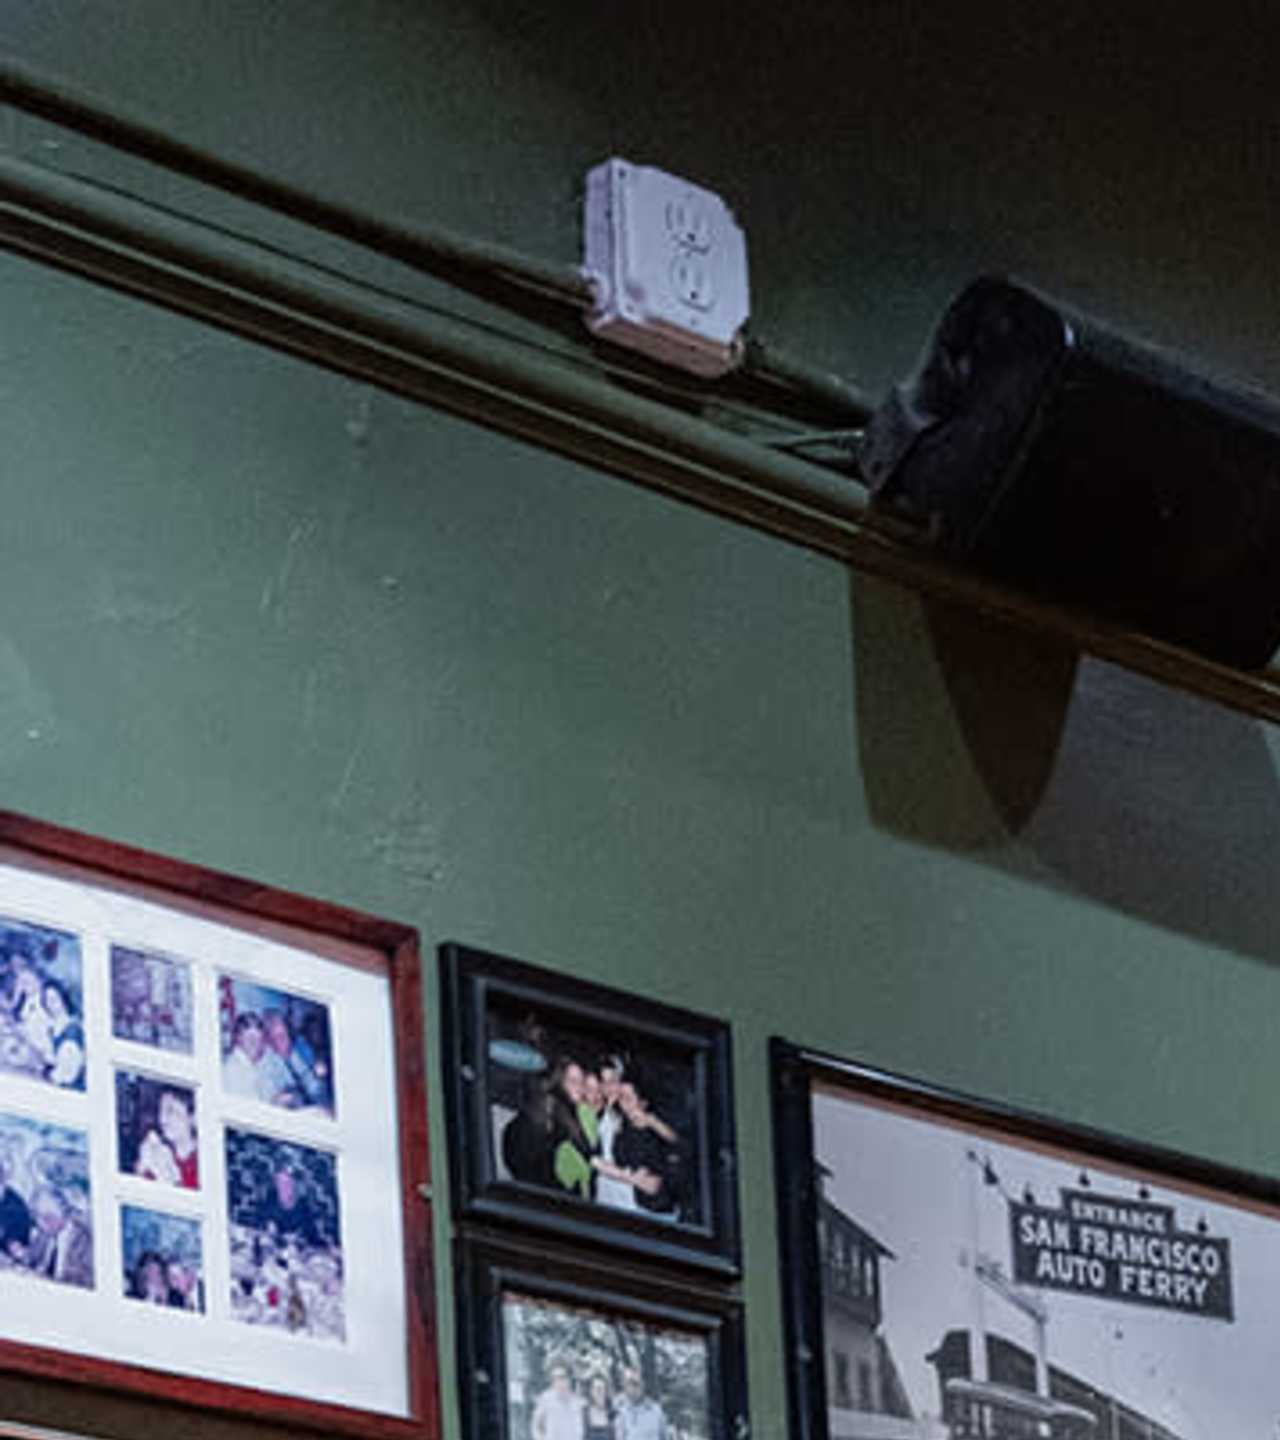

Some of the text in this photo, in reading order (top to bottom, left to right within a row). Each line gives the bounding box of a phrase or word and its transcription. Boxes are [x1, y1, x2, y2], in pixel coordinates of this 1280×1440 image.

[1019, 1214, 1220, 1276] SAN FRANCISCO
[1071, 1200, 1167, 1233] ENTRANCE
[1035, 1250, 1208, 1307] AUTO FERRY
